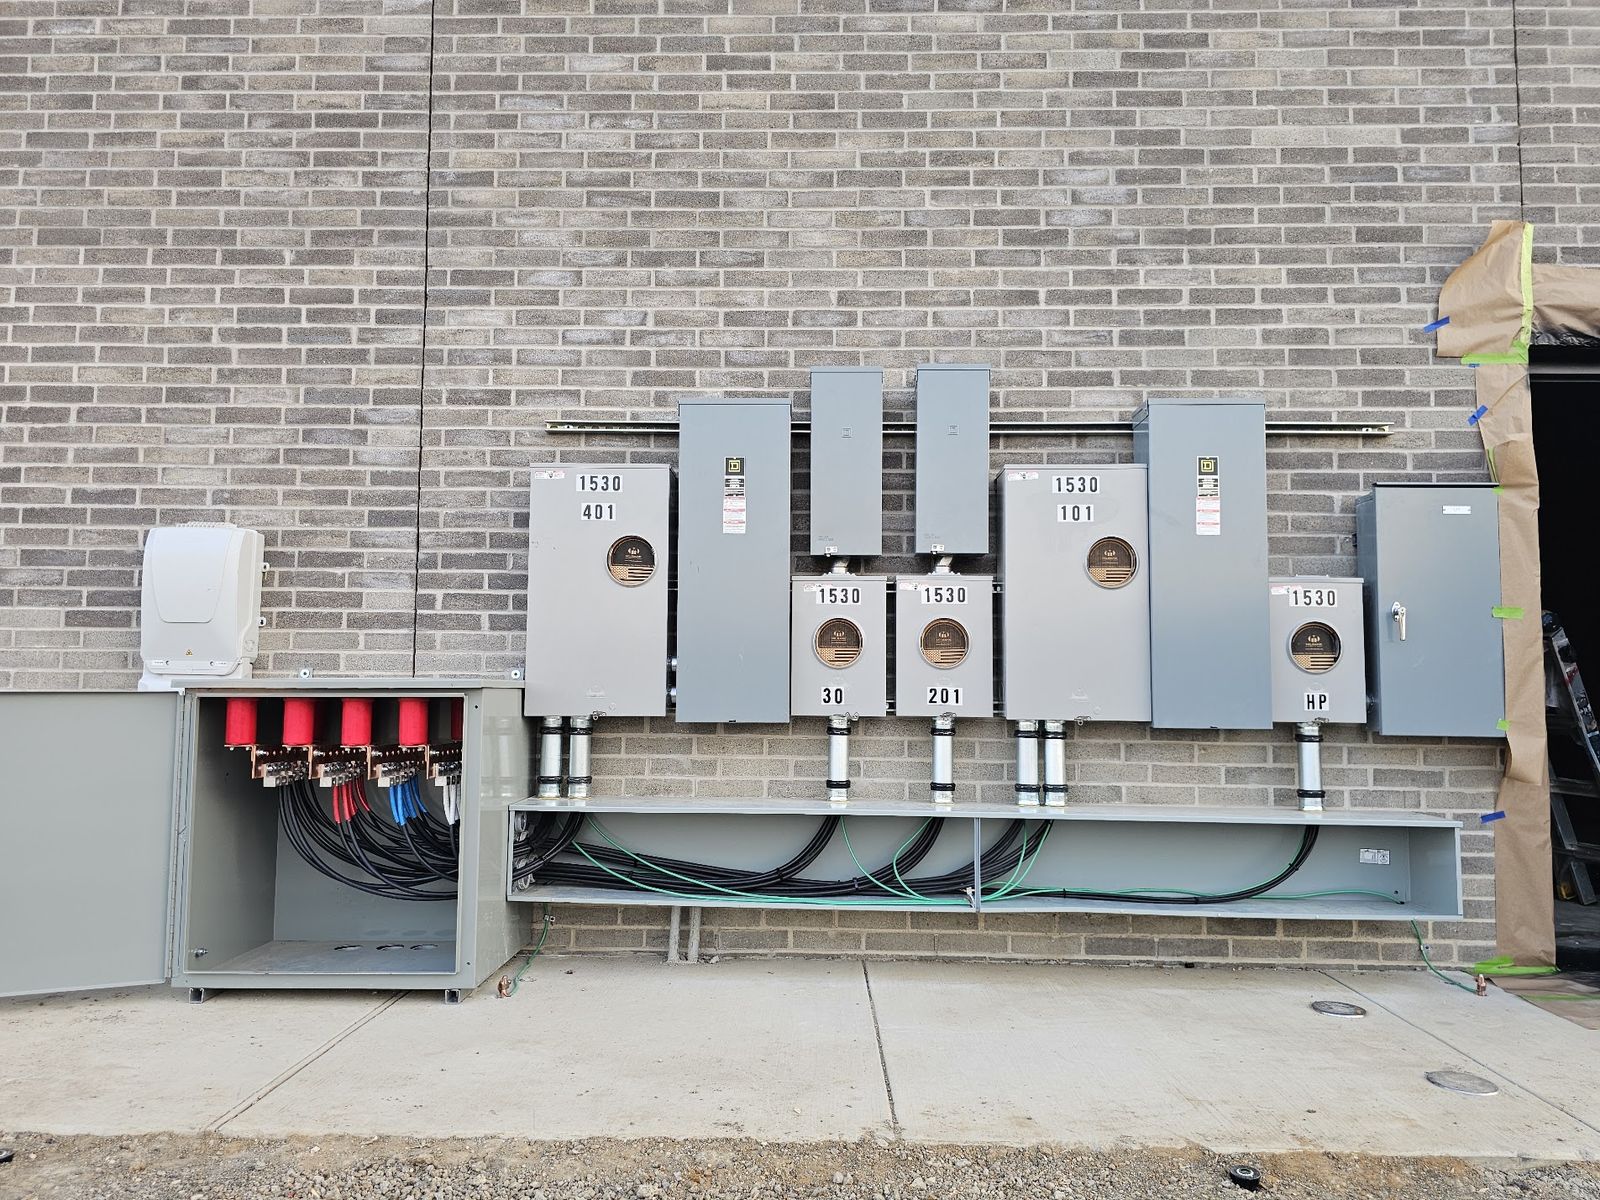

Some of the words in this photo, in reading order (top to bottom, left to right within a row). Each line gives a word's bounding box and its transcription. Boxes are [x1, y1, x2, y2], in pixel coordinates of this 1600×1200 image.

[580, 475, 621, 491] 1530
[1056, 477, 1098, 493] 1530
[583, 504, 614, 520] 401
[1061, 505, 1092, 521] 101
[819, 588, 860, 604] 1530
[924, 587, 966, 603] 1530
[1293, 590, 1336, 606] 1530
[822, 687, 843, 704] 30
[928, 688, 959, 704] 201
[1306, 694, 1327, 710] HP
